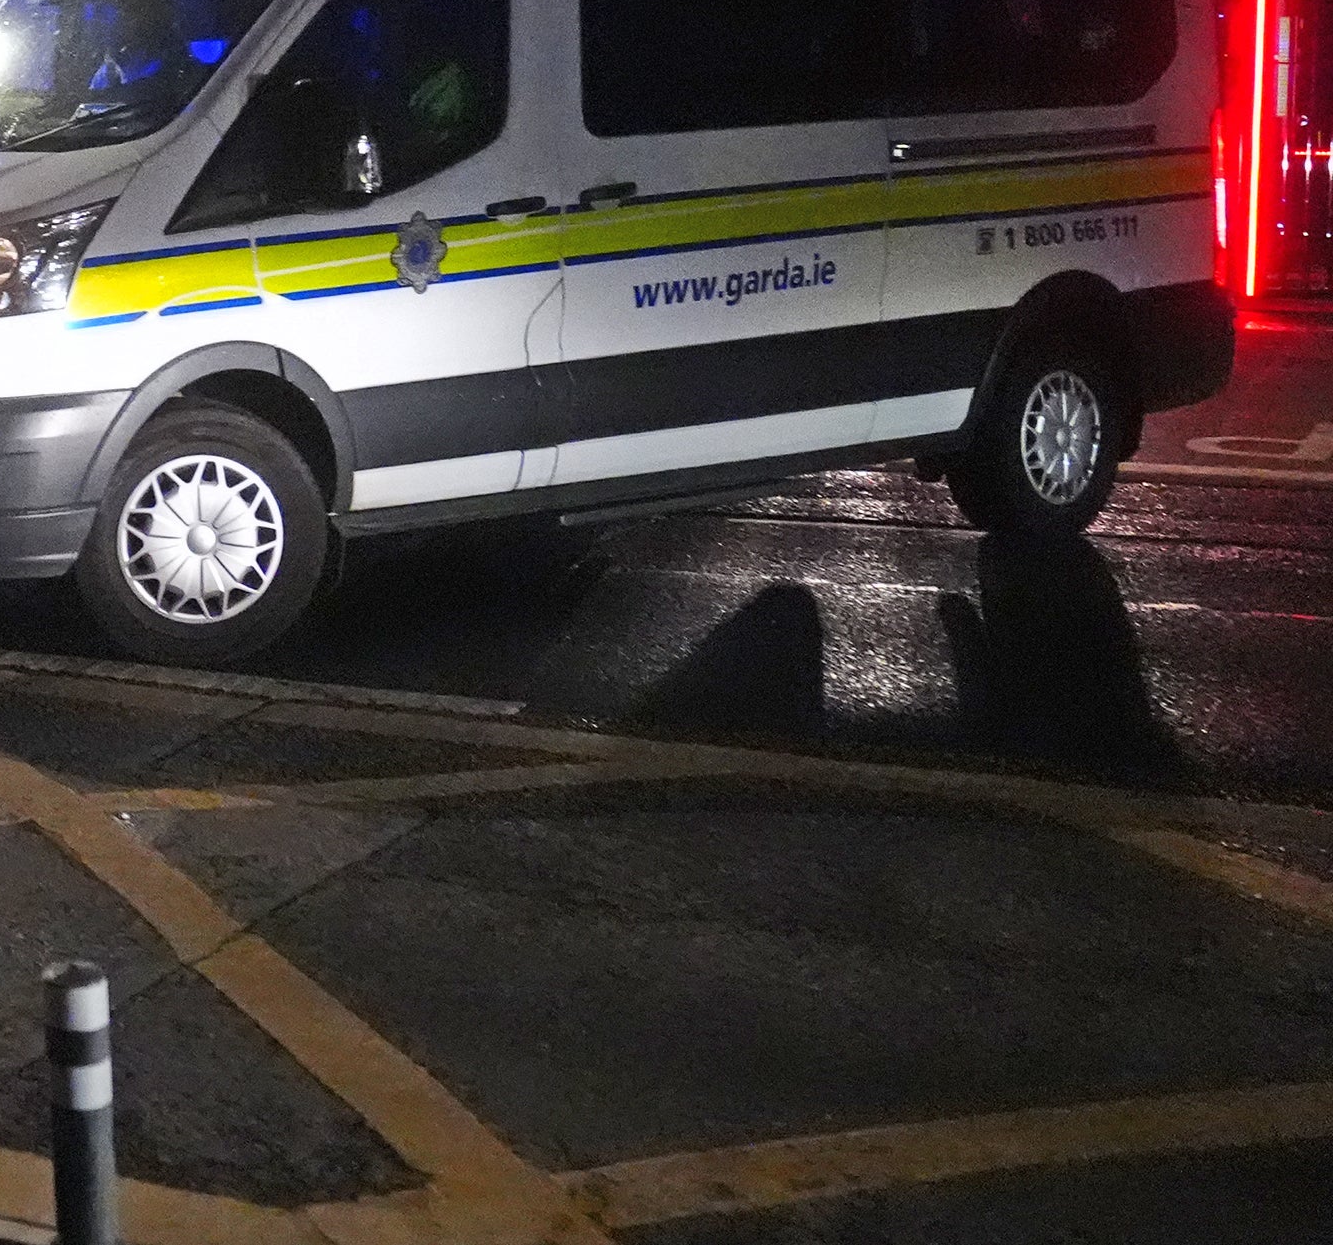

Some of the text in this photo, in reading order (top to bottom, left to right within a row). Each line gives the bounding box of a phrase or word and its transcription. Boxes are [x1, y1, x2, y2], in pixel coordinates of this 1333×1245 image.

[1004, 215, 1138, 250] 1 800 666 111
[633, 254, 836, 308] www.garda.ie
